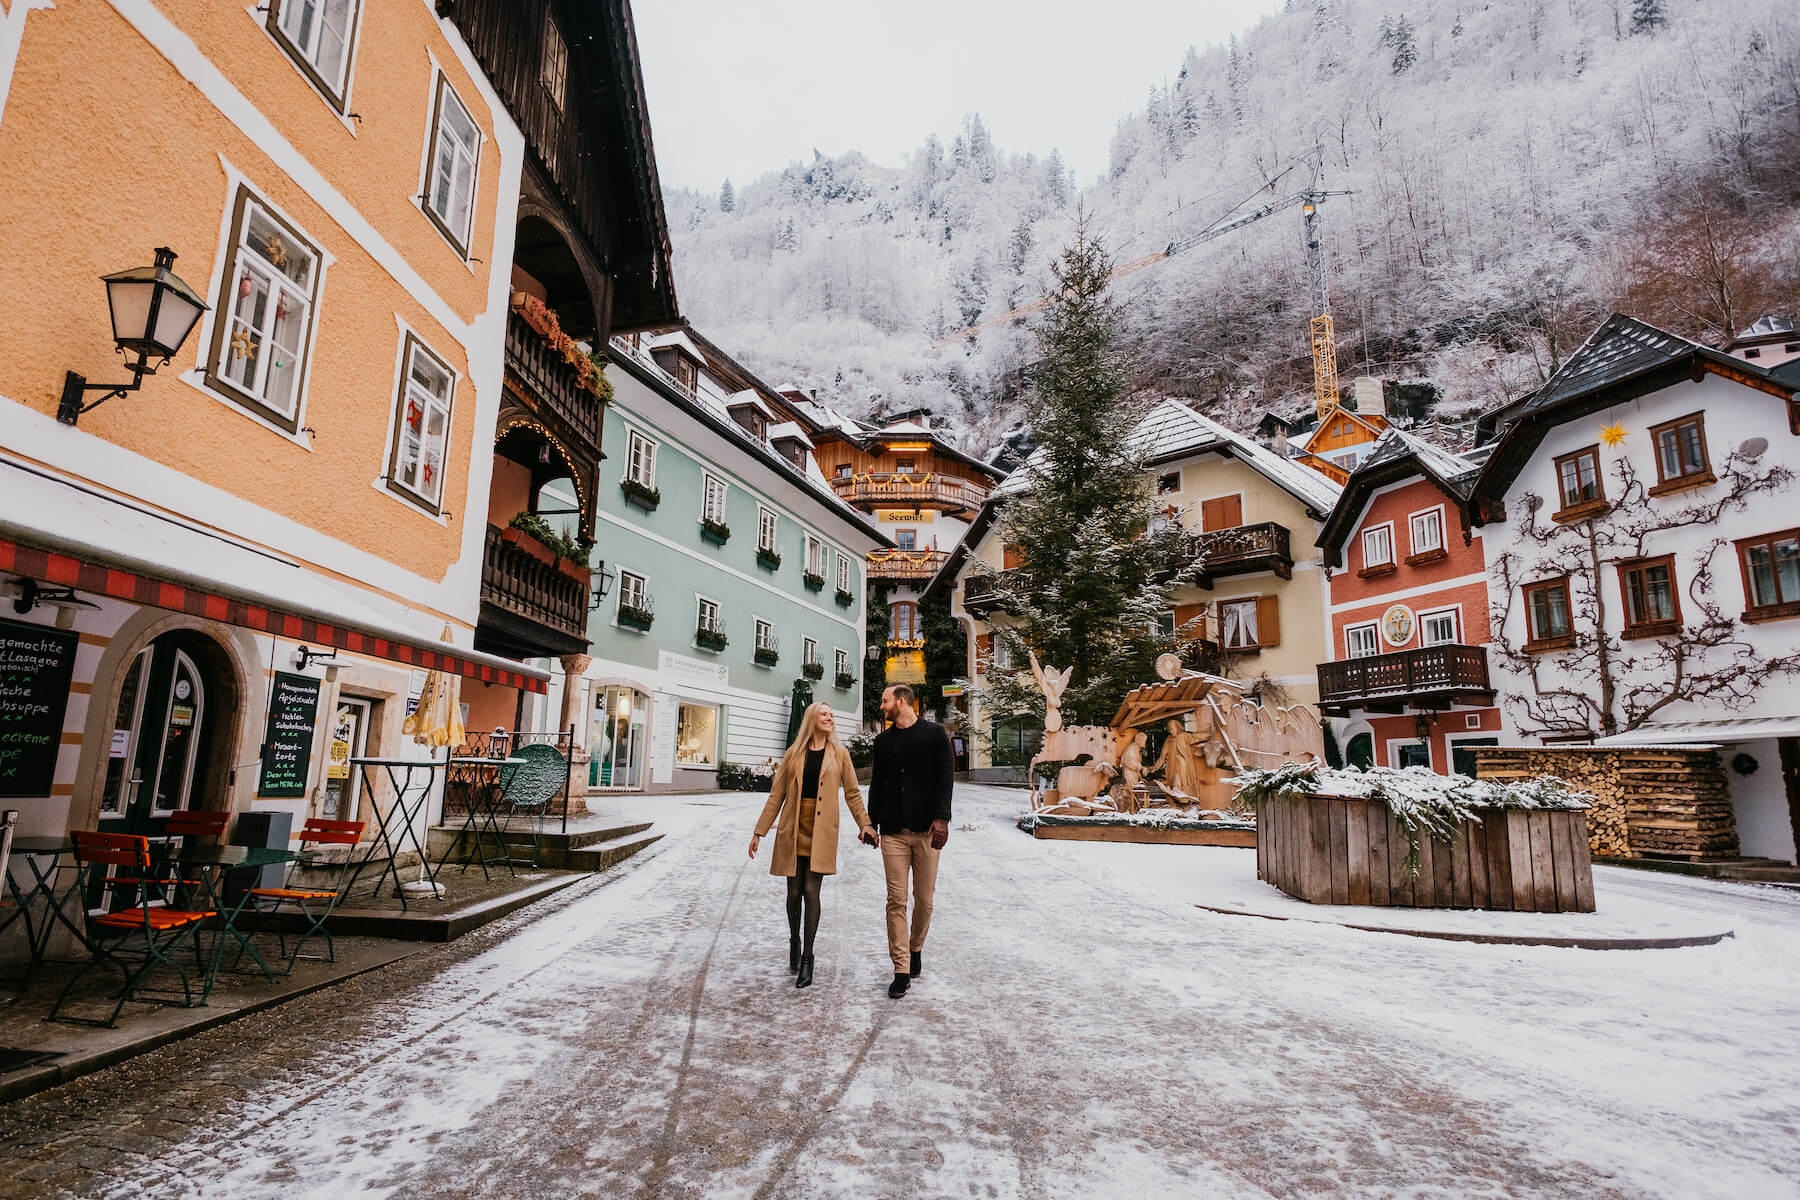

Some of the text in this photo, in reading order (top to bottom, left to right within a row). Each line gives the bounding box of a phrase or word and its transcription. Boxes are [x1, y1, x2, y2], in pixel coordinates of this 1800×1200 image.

[888, 512, 923, 521] Seewirt
[8, 651, 58, 668] Lasagne
[0, 700, 49, 716] hsuppe
